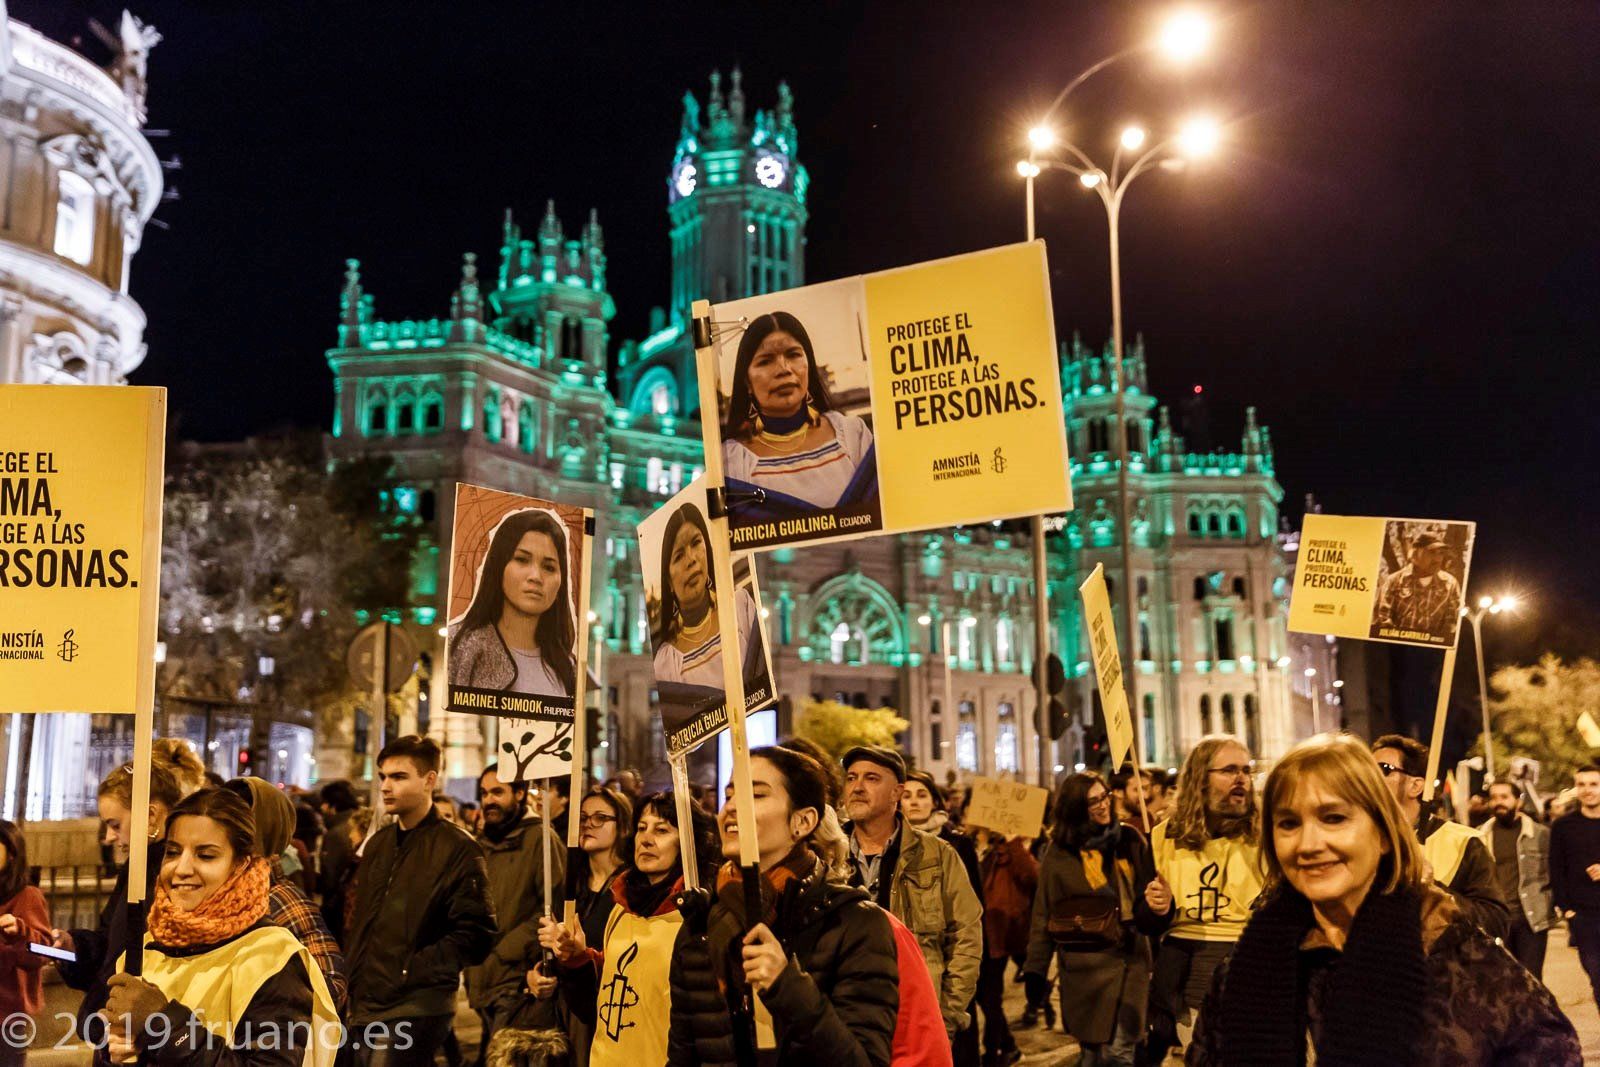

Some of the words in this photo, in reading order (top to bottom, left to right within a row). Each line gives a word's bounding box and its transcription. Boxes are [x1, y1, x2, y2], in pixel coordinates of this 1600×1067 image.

[887, 316, 951, 343] PROTEGE
[955, 312, 973, 331] EL
[890, 333, 979, 376] CLIMA,
[892, 370, 956, 397] PROTEGE
[961, 368, 970, 386] A
[973, 363, 1000, 383] LAS
[895, 377, 1046, 430] PERSONAS.
[36, 452, 58, 473] EL
[932, 451, 980, 471] AMNISTÍA
[933, 467, 982, 481] INTERNACIONAL
[0, 477, 62, 523] MA,
[0, 523, 27, 543] GE
[33, 523, 46, 544] A
[51, 523, 85, 544] LAS
[779, 514, 836, 536] GUALINGA
[839, 514, 872, 528] ECUADOR
[1307, 548, 1346, 566] CLIMA,
[1303, 572, 1369, 592] PERSONAS.
[1, 629, 44, 648] NISTÍA
[453, 691, 498, 710] MARINEL
[501, 696, 543, 714] SUMOOK
[670, 719, 705, 750] PATRICIA
[703, 704, 729, 730] GUALI
